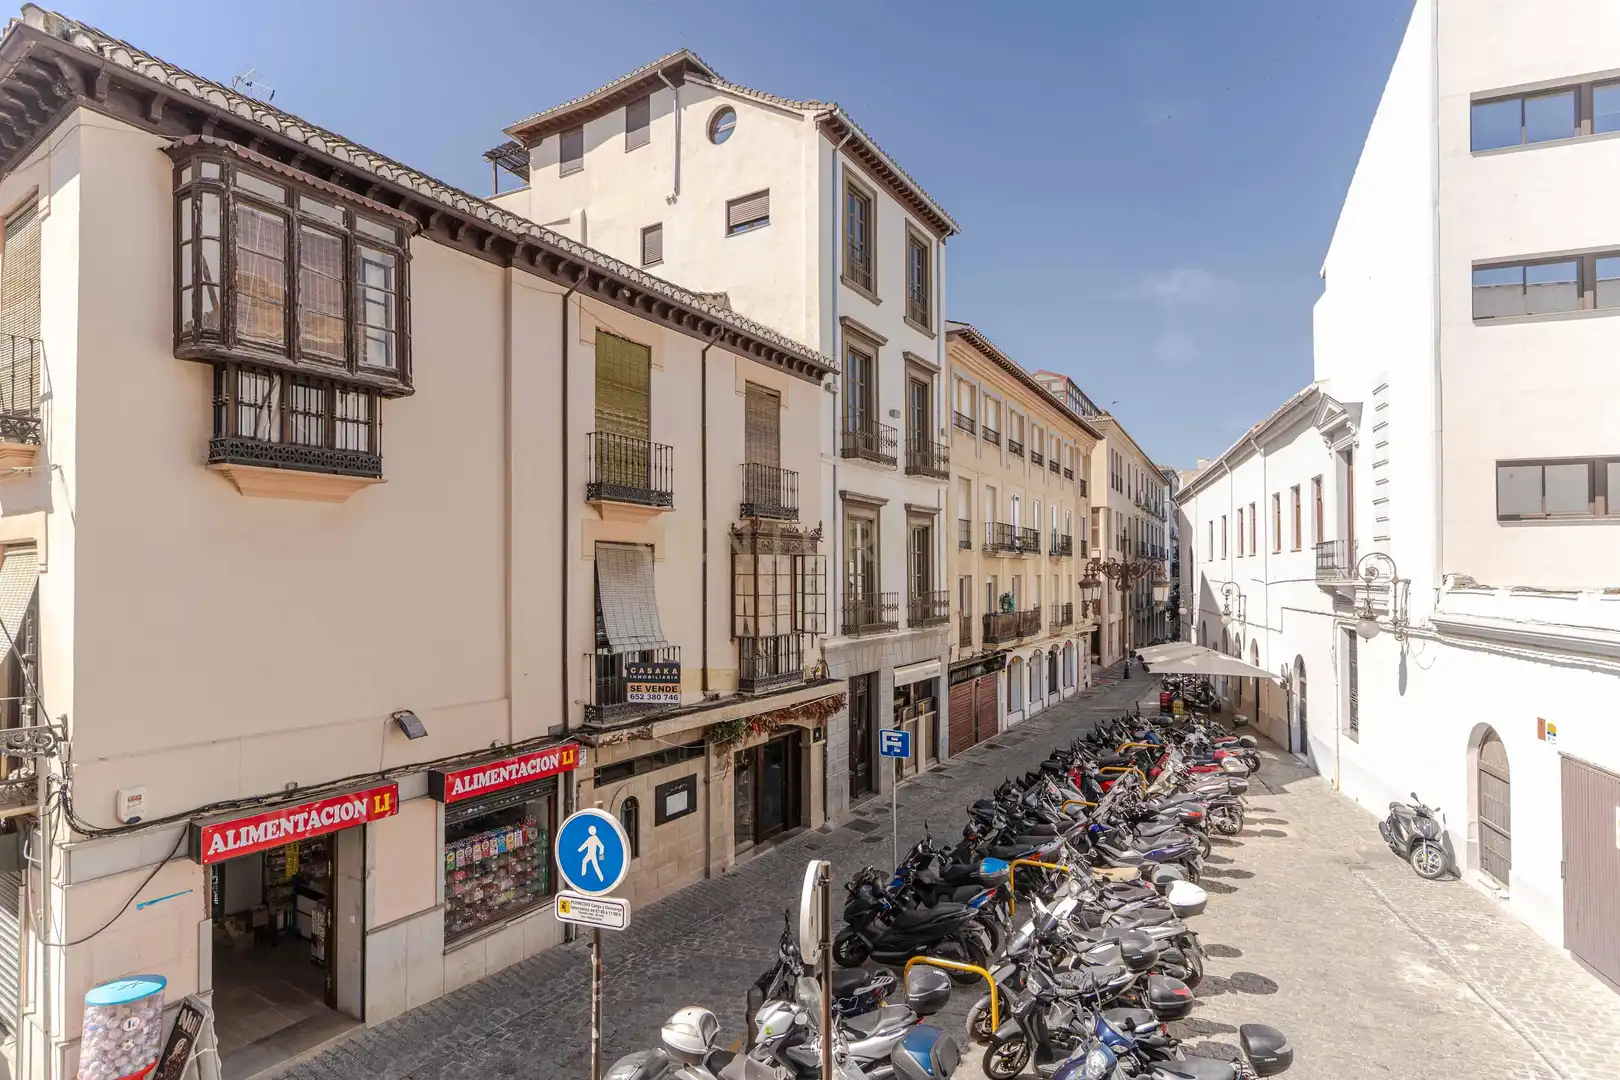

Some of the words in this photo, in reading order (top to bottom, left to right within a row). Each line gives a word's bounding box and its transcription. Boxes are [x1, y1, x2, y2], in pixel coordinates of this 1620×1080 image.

[645, 685, 678, 693] VENDE
[451, 754, 559, 795] ALIMENTACION
[562, 749, 575, 766] LI
[207, 798, 368, 856] ALIMENTACION
[373, 792, 391, 814] LI
